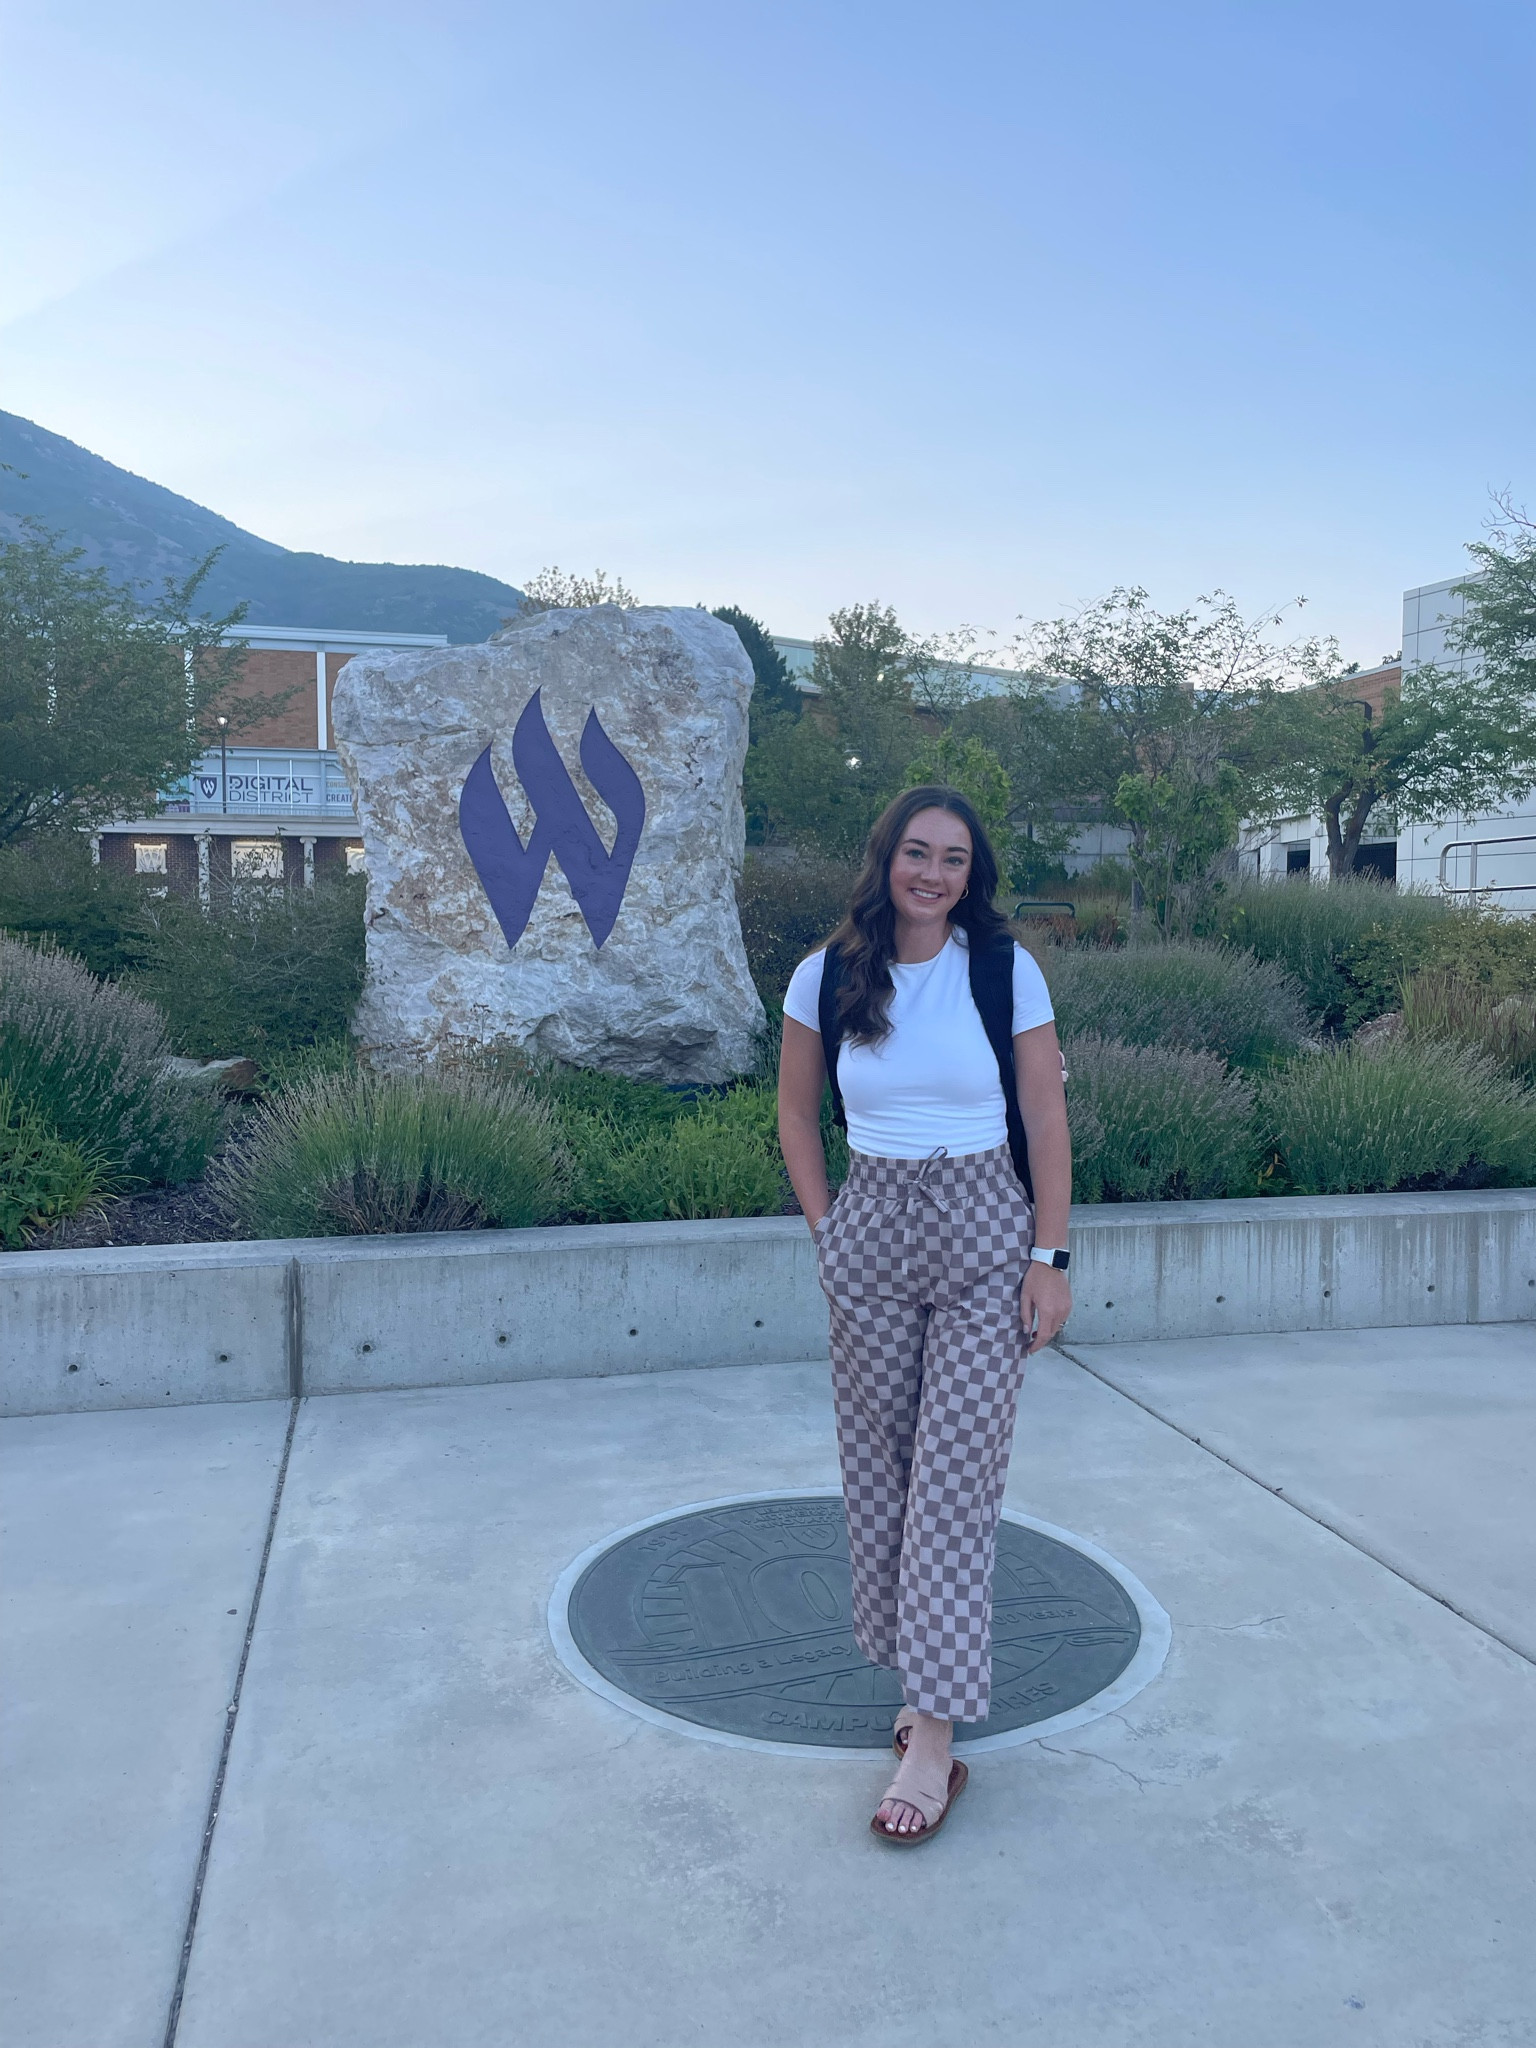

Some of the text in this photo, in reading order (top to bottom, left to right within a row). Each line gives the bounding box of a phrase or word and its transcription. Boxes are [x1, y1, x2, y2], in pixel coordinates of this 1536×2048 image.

[229, 775, 313, 791] DIGITAL
[229, 790, 313, 804] DISTRICT
[750, 1516, 848, 1531] INNOVATIO
[1016, 1608, 1078, 1623] Years
[654, 1645, 854, 1684] Building a Legacy
[989, 1682, 1060, 1714] ORES
[760, 1709, 896, 1732] CAMPU
